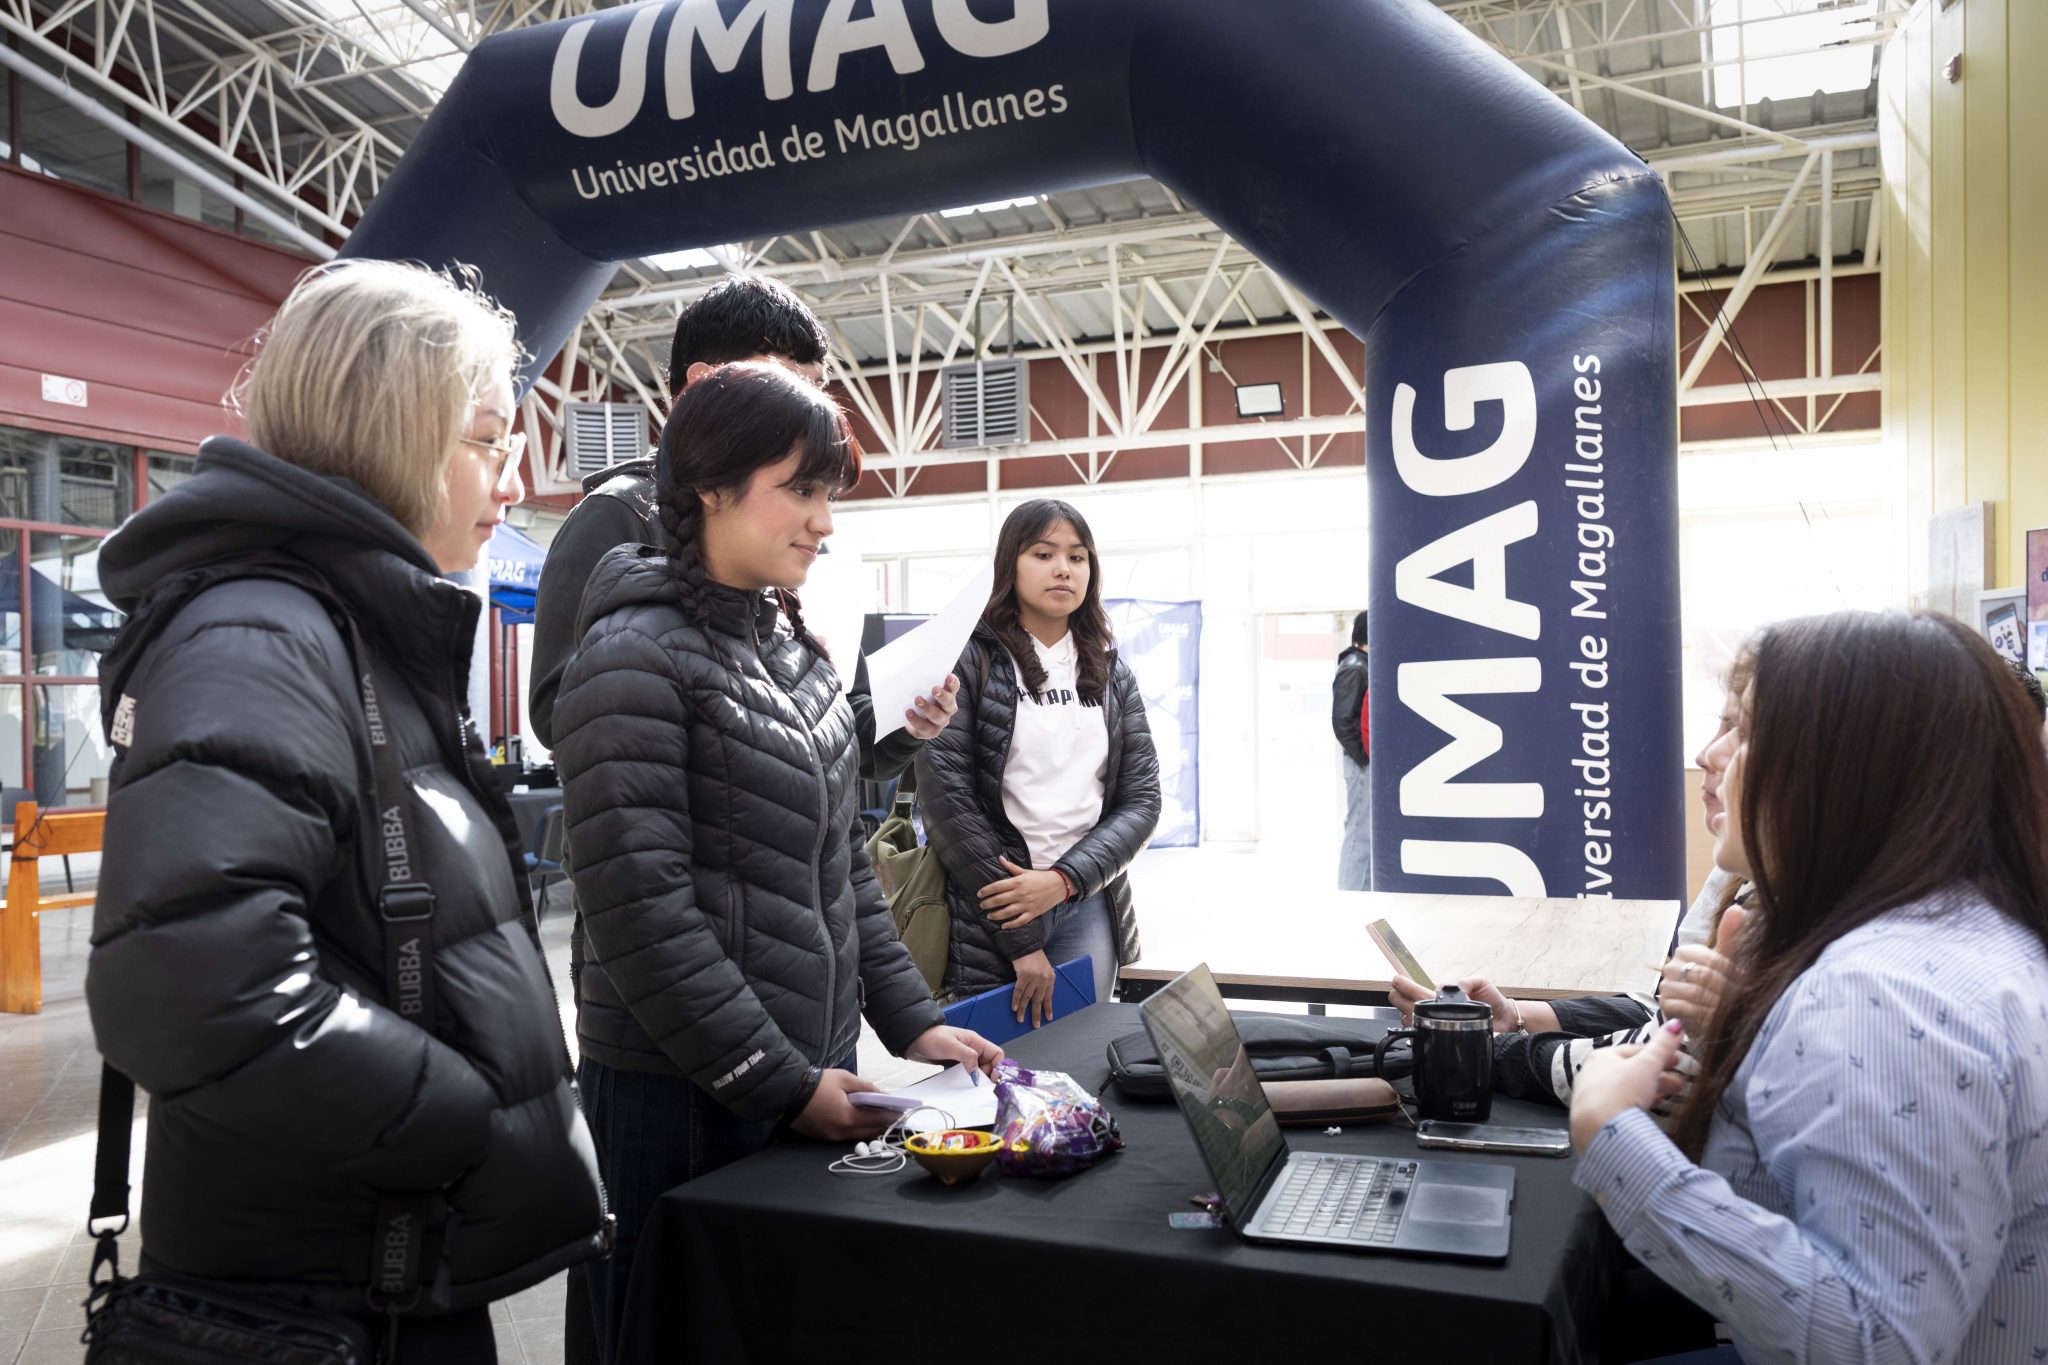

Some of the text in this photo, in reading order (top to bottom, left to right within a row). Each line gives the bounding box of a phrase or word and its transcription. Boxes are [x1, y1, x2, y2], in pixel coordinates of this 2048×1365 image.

[571, 84, 1069, 200] Universidad de Magallanes
[487, 558, 527, 583] MAG
[1564, 353, 1615, 900] iversidad de Magallanes
[362, 673, 387, 745] BUBBA
[382, 804, 411, 882] BUBBA
[399, 937, 422, 1015] BUBBA
[381, 1213, 412, 1294] BUBBA
